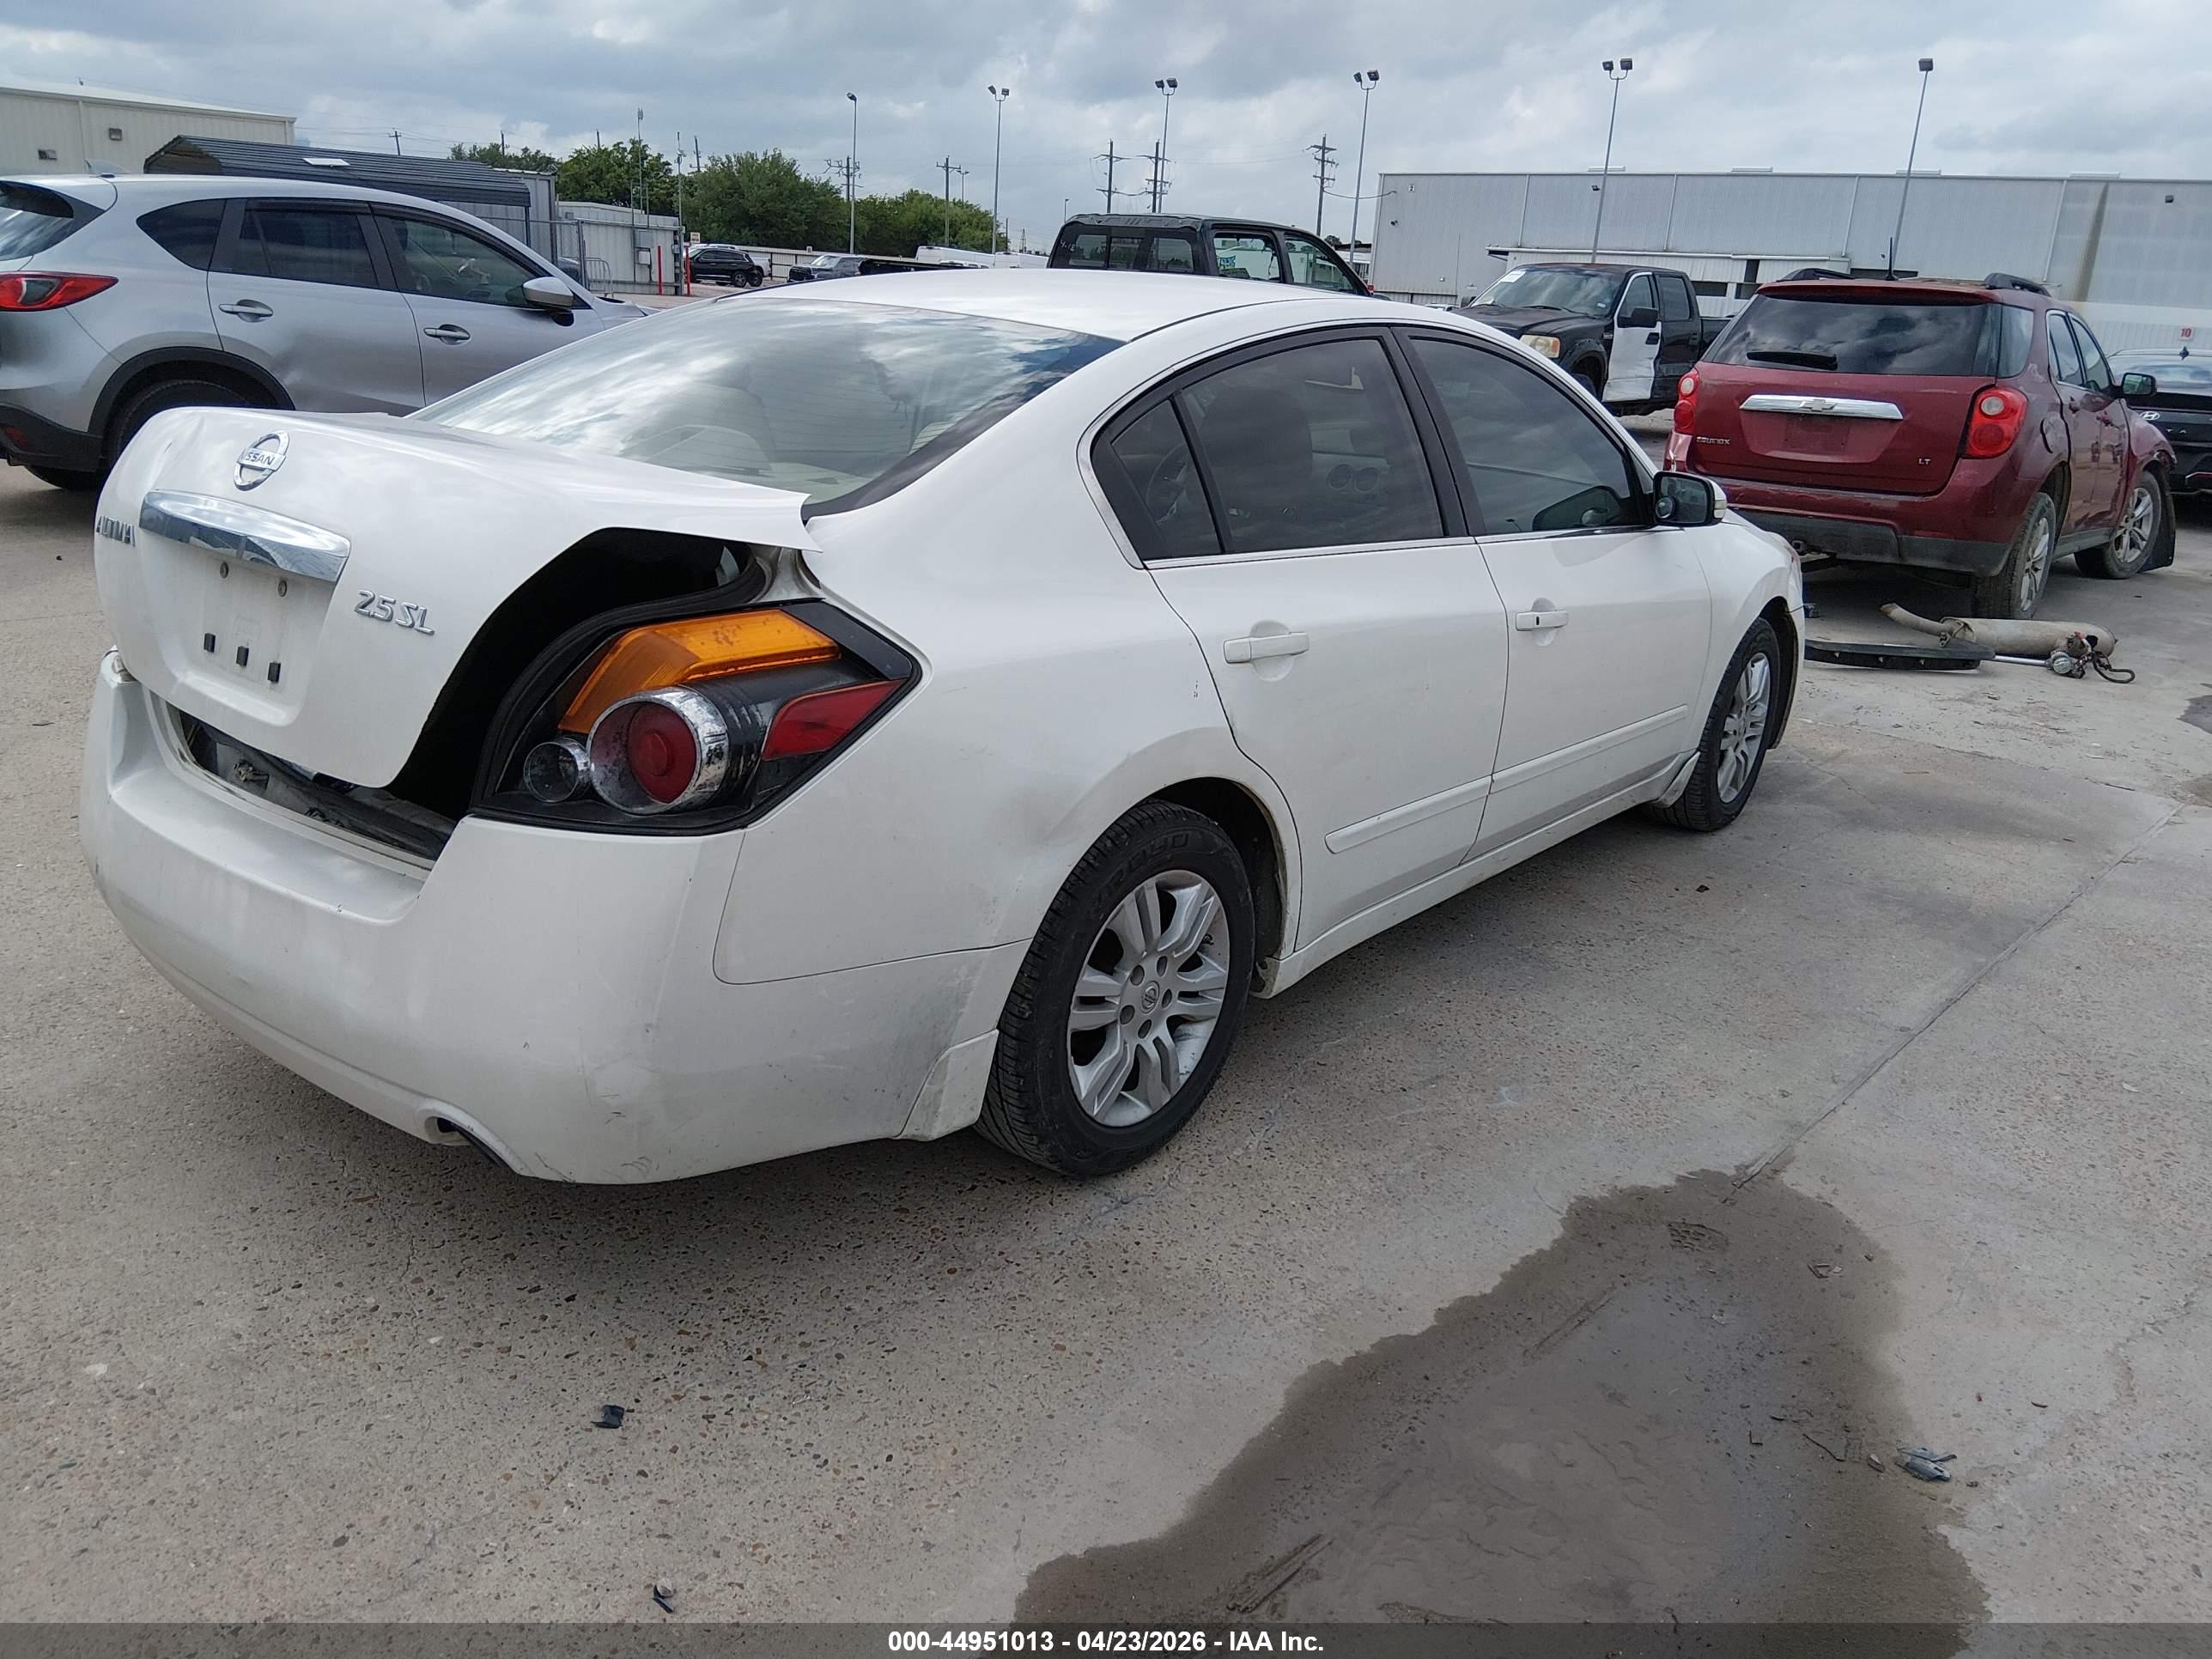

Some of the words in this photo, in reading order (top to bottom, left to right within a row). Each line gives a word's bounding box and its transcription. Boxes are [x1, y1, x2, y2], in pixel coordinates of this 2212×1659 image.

[2179, 328, 2192, 337] 10
[238, 448, 276, 466] NISSAN
[395, 601, 435, 636] SL
